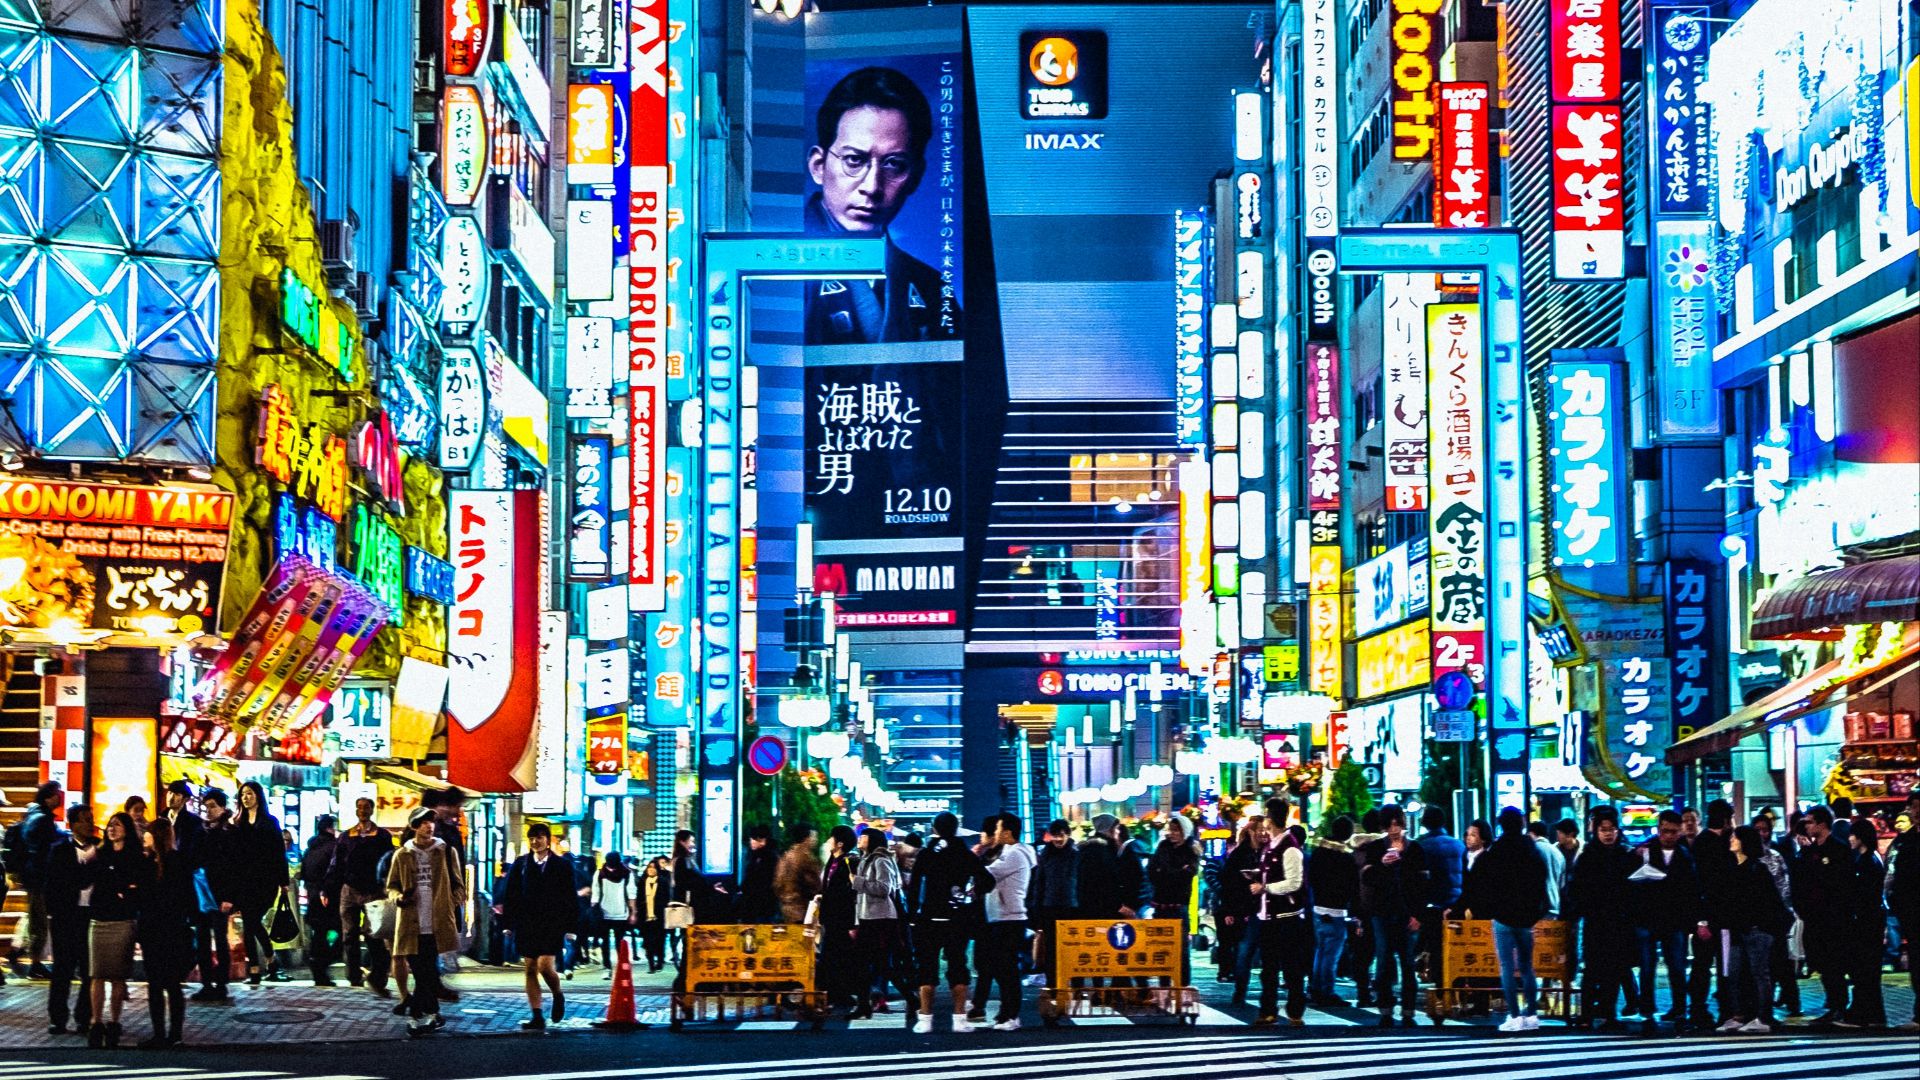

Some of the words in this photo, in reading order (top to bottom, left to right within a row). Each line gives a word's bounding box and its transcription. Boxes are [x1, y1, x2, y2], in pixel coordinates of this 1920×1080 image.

[632, 0, 666, 97] AX
[1025, 133, 1100, 149] IMAX
[1777, 163, 1806, 214] Don
[630, 191, 657, 253] BIC
[1308, 249, 1337, 324] Booth
[630, 266, 657, 371] DRUG
[816, 381, 923, 426] 海賊と
[710, 315, 733, 552] GODZILLA
[816, 425, 914, 451] よばれた
[816, 453, 856, 495] 男
[1560, 370, 1611, 556] カラオケ
[148, 490, 233, 526] YAKI
[883, 487, 952, 513] 12.10
[884, 513, 951, 525] ROADSHOW
[63, 539, 107, 556] Drinks
[108, 541, 130, 557] for
[131, 543, 141, 557] 2
[141, 544, 182, 561] hours
[66, 524, 111, 540] dinner
[112, 526, 141, 541] with
[456, 504, 487, 637] トラノコ
[856, 564, 955, 592] MARUHAN
[1435, 500, 1485, 625] 金の蔵
[709, 580, 732, 690] ROAD
[1675, 569, 1710, 717] カラオケ
[1620, 656, 1657, 779] カラオケ
